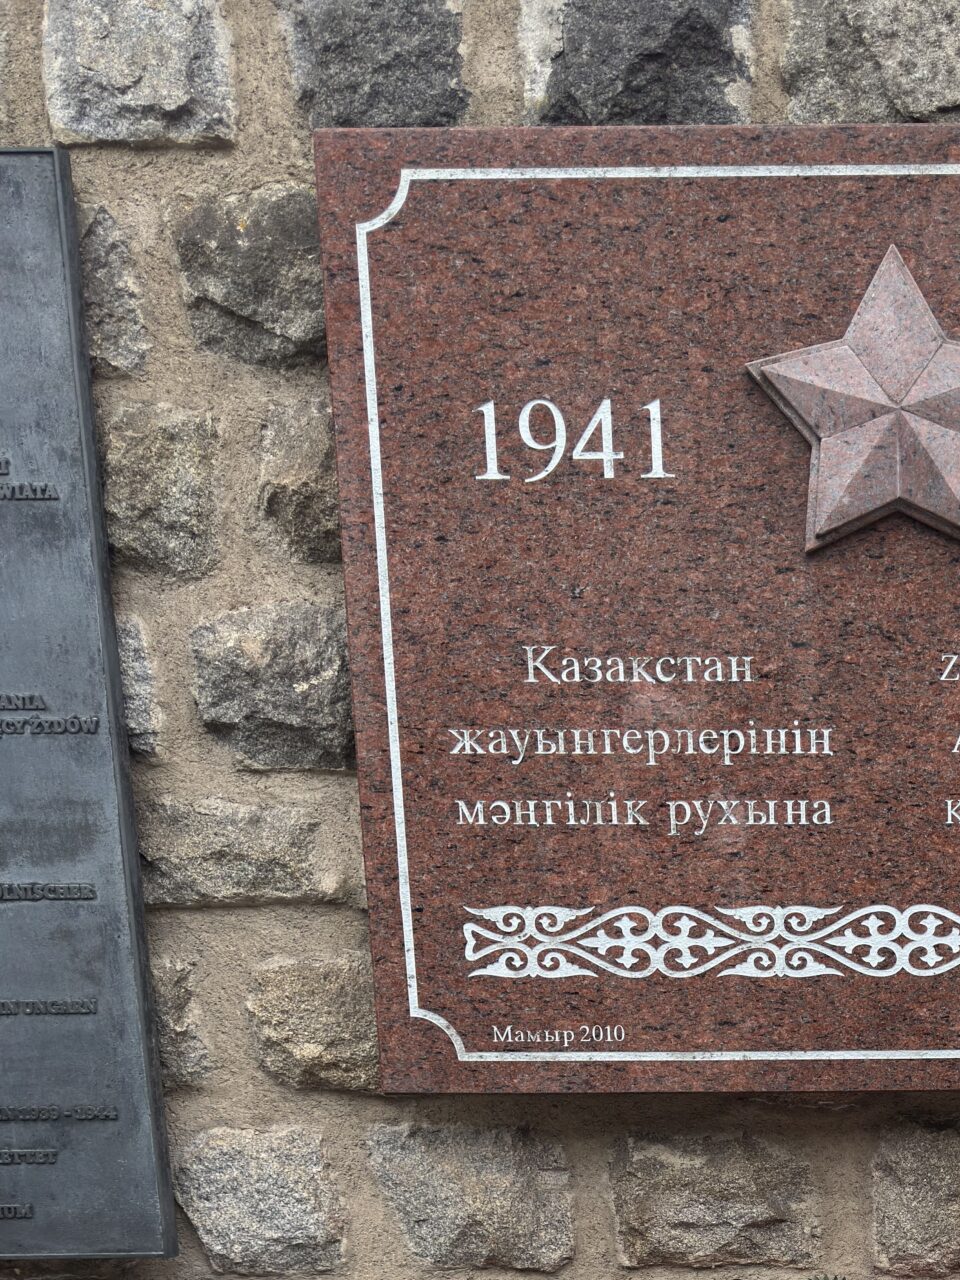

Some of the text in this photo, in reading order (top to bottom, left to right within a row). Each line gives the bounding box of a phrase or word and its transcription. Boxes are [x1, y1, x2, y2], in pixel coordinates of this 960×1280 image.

[474, 398, 676, 483] 1941
[448, 720, 834, 766] жауынгерлерінің
[455, 791, 834, 836] мәңгілік рухына
[491, 1024, 625, 1047] Мамыр 2010
